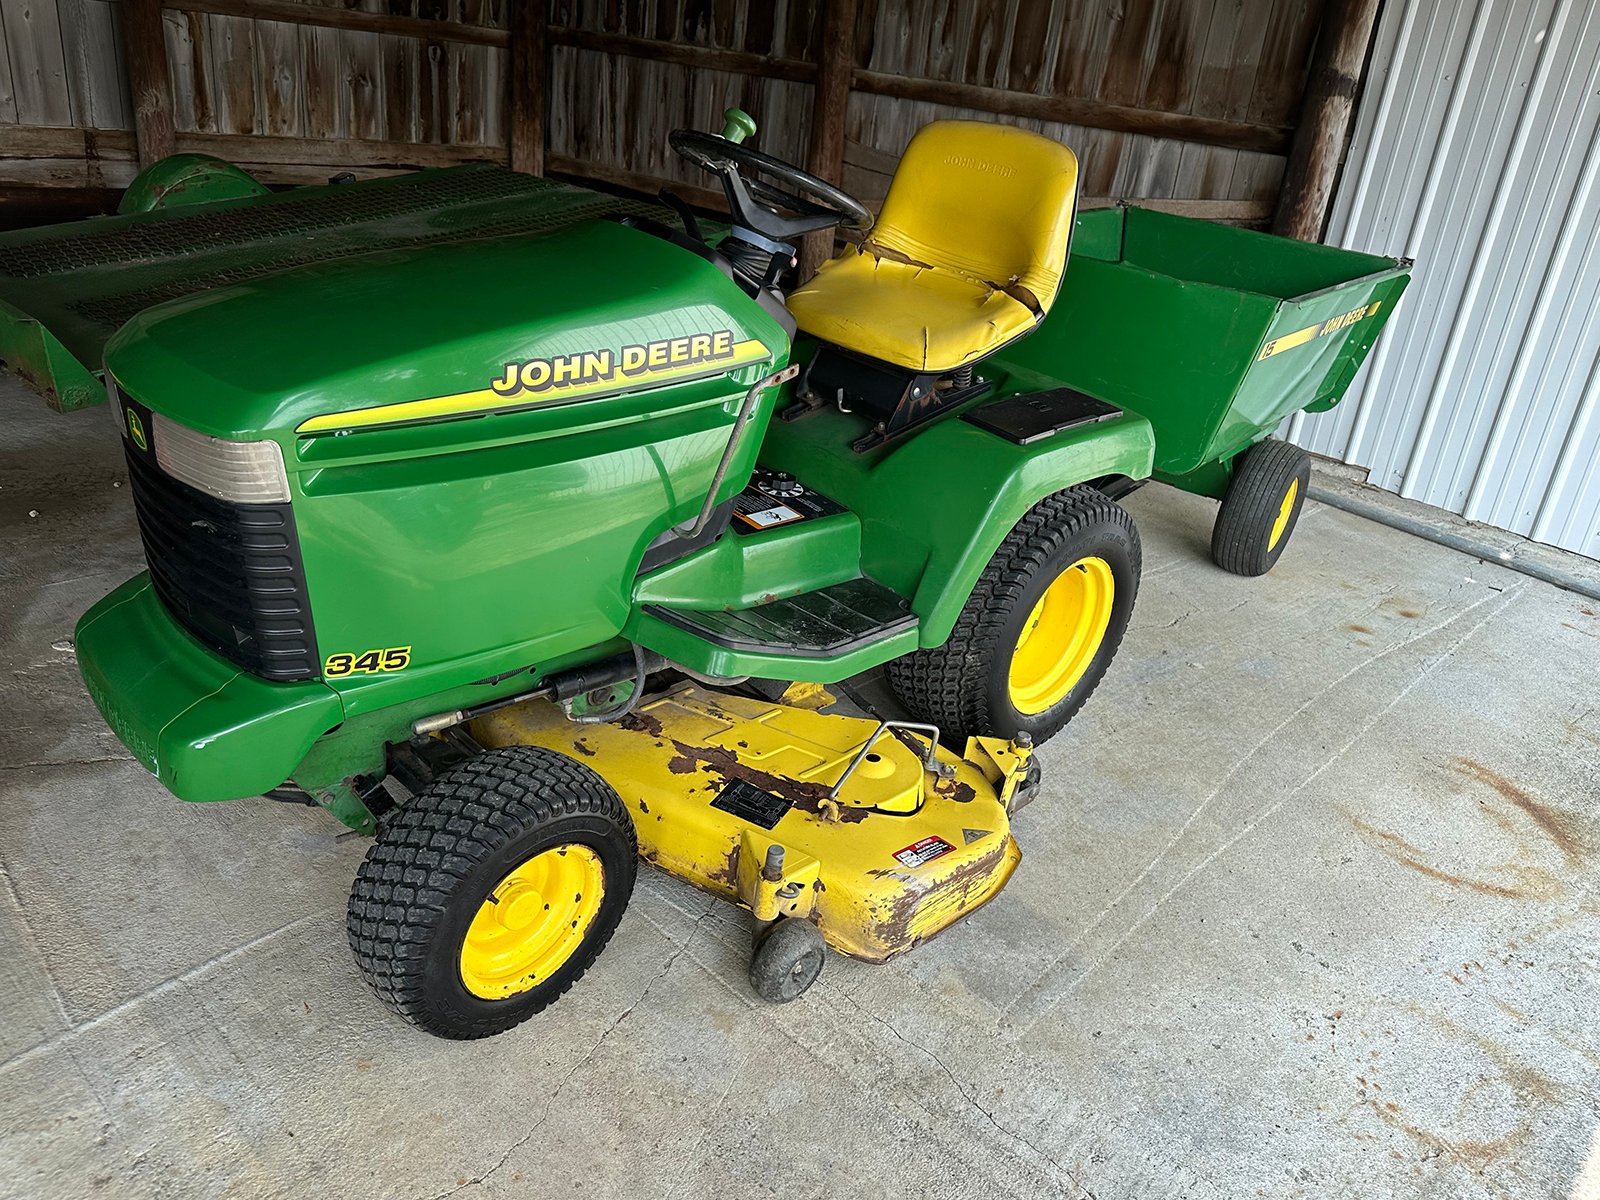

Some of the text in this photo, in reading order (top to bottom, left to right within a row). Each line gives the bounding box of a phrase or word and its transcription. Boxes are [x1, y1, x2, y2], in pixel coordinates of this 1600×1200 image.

[491, 330, 734, 396] JOHN DEERE
[324, 646, 411, 677] 345
